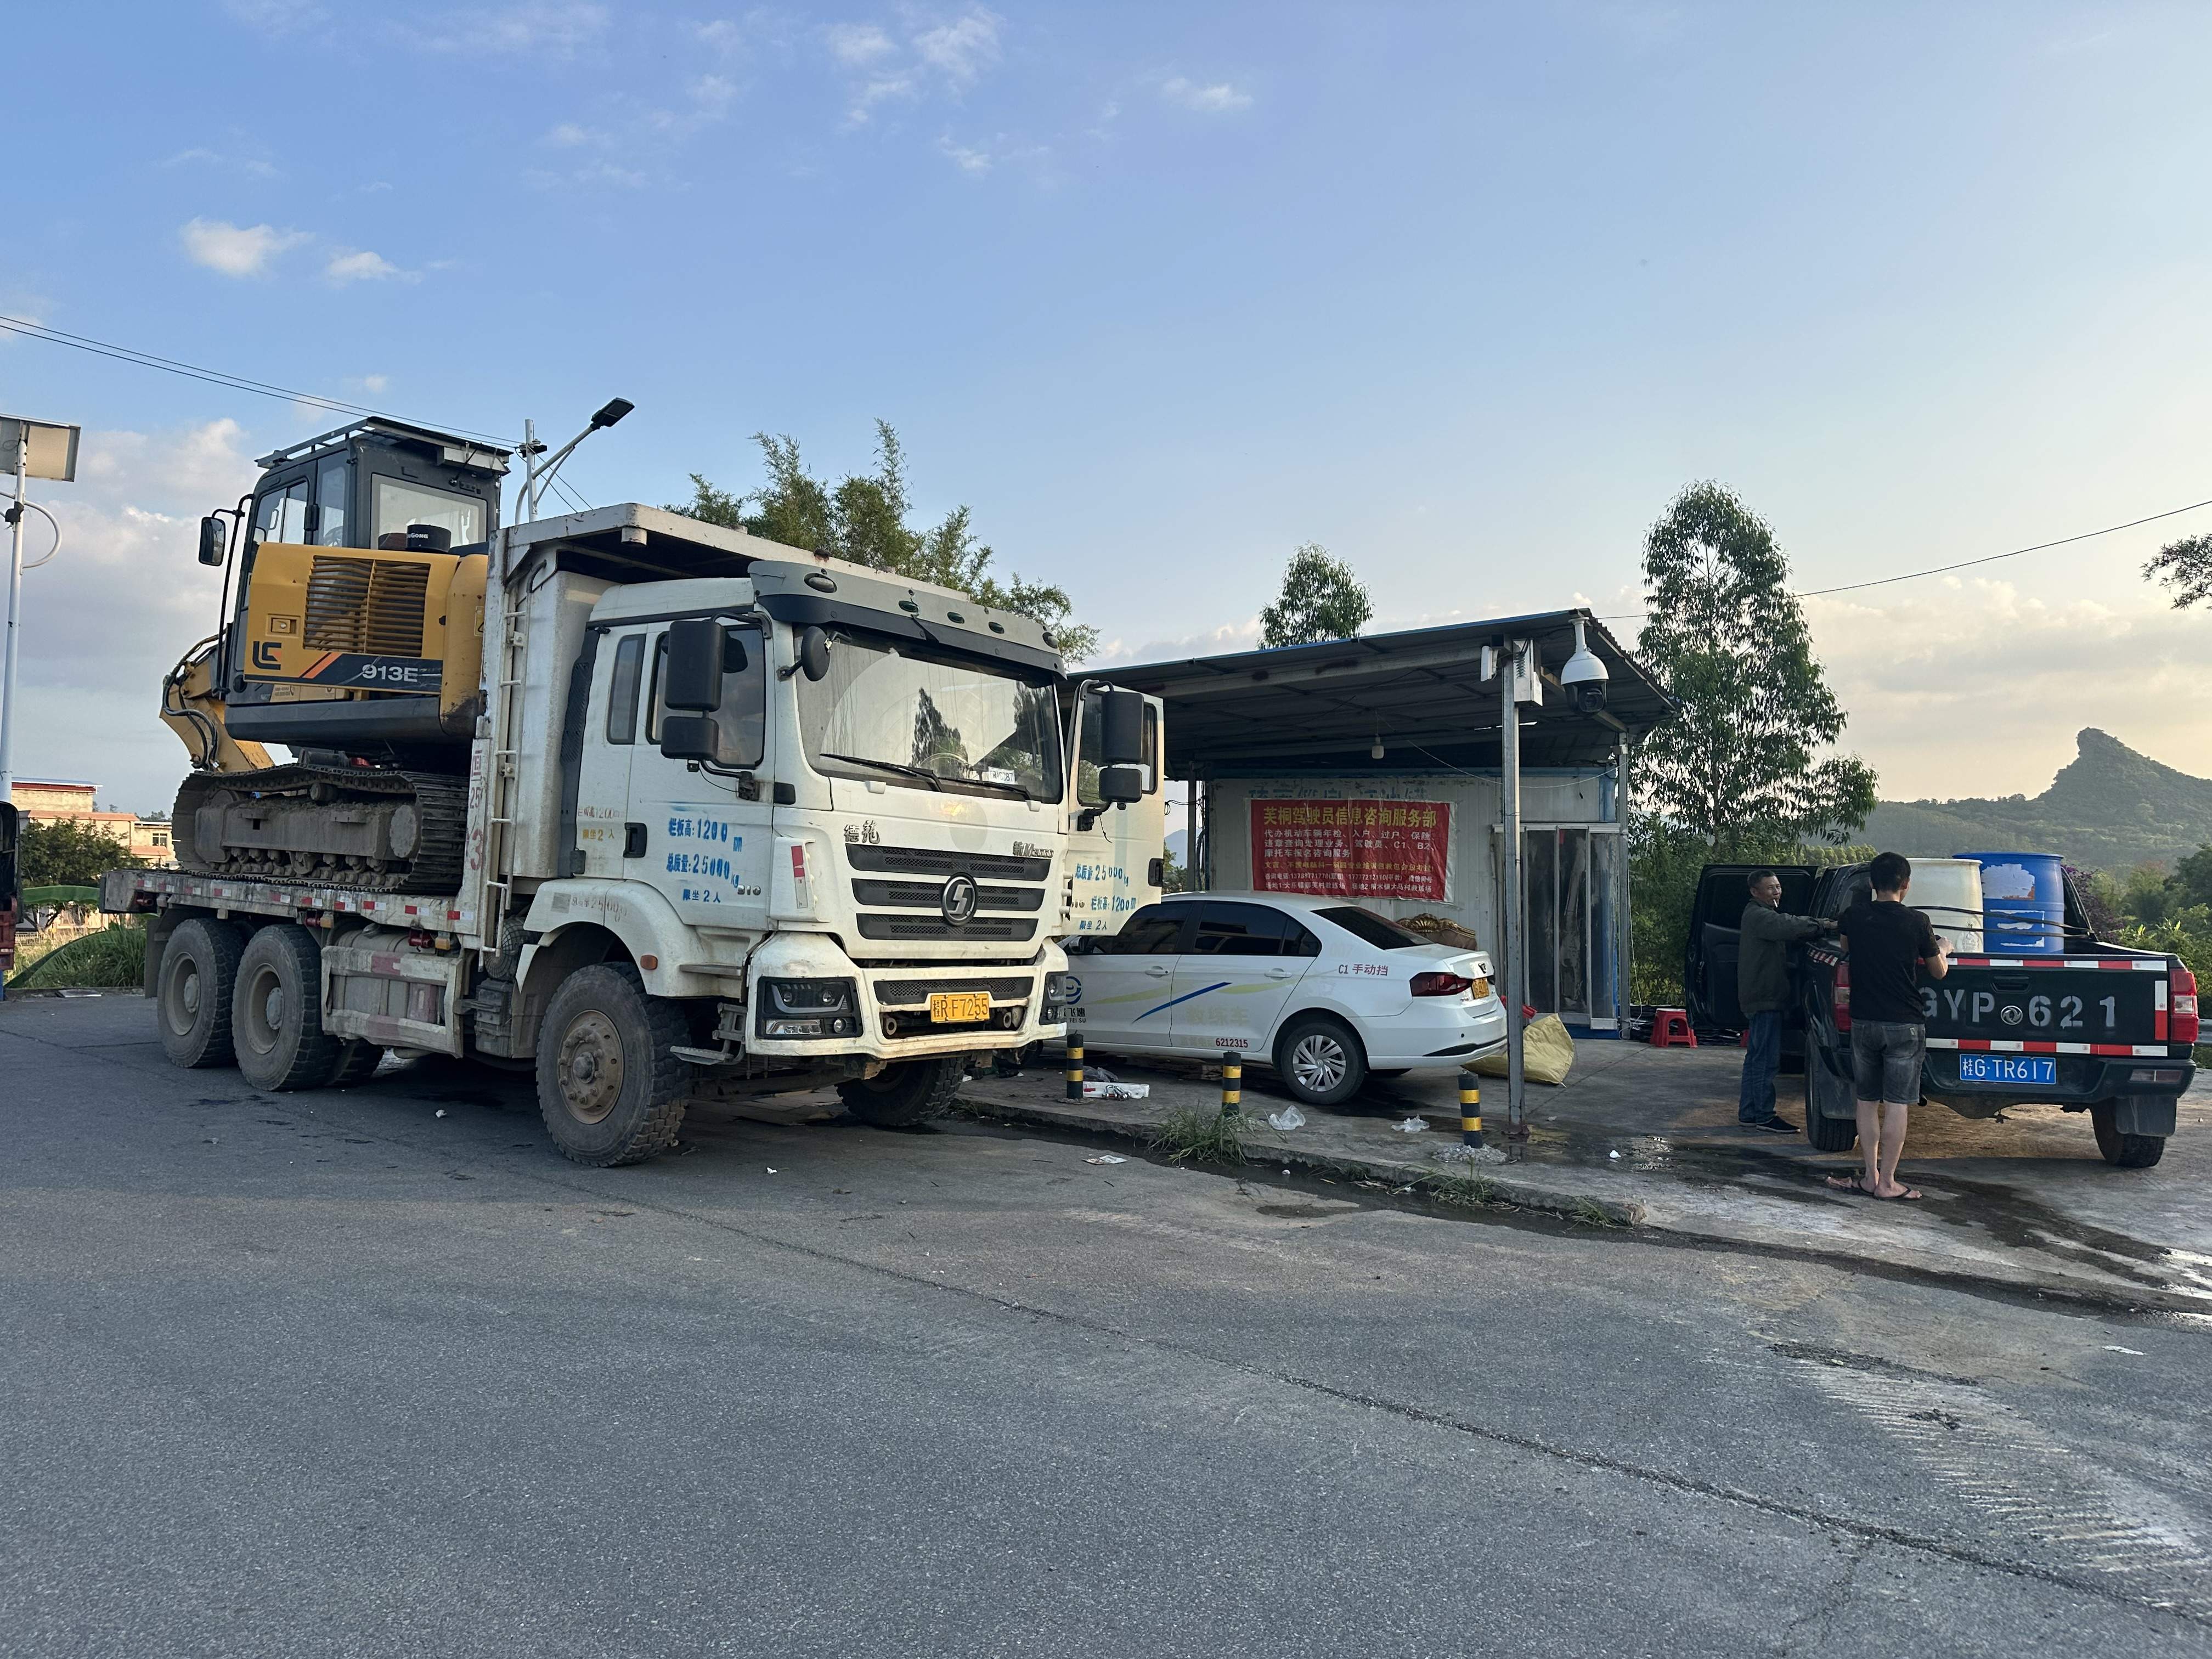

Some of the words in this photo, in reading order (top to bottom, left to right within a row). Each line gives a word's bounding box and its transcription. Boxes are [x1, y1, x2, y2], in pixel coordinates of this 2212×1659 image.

[362, 664, 418, 682] 913E
[1263, 806, 1436, 828] 芙桐驾驶员信息咨询服务部
[1265, 849, 1351, 857] 摩托车报名咨询服务
[737, 885, 761, 895] 310
[1338, 964, 1349, 974] C1
[1352, 964, 1389, 976] 手动挡
[1064, 1007, 1086, 1017] 飞速
[1215, 1037, 1249, 1048] 6212315
